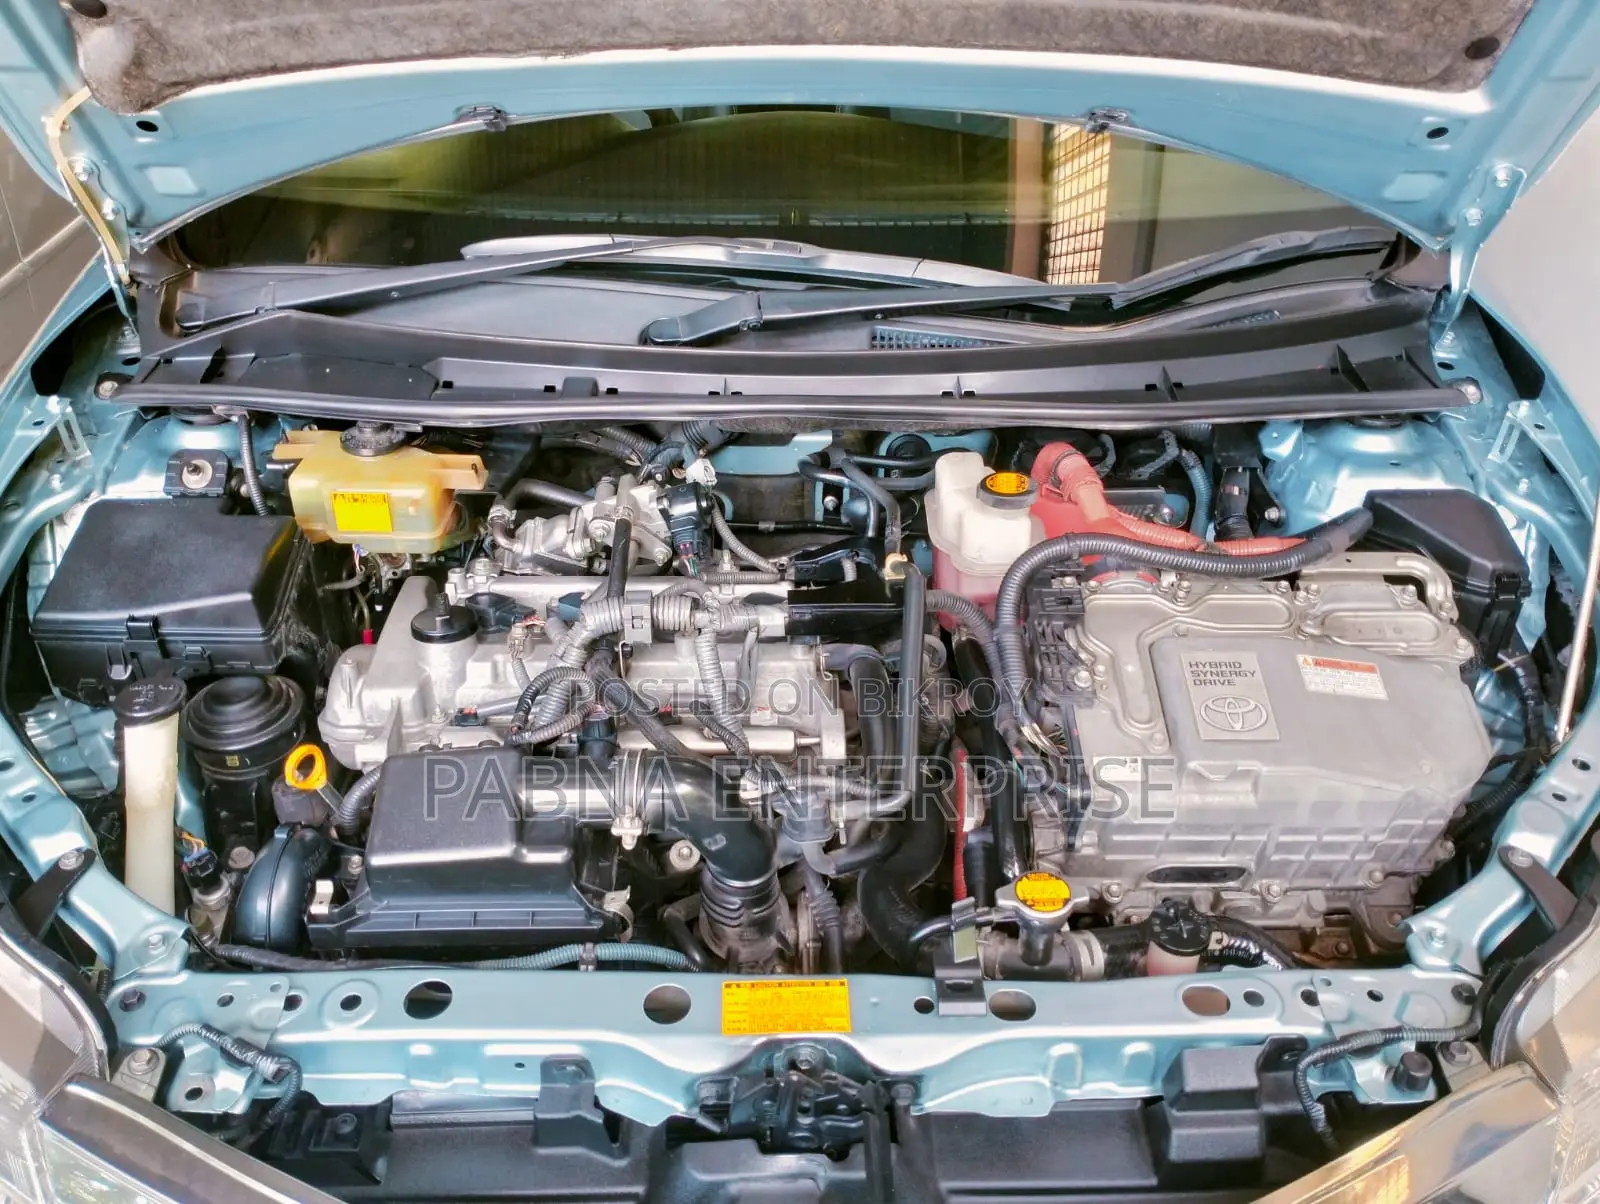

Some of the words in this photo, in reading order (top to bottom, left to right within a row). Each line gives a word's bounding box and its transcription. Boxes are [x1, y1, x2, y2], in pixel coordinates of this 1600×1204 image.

[1189, 661, 1243, 669] HYBRID
[1191, 670, 1256, 678] SYNERGY
[1193, 678, 1236, 687] DRIVE
